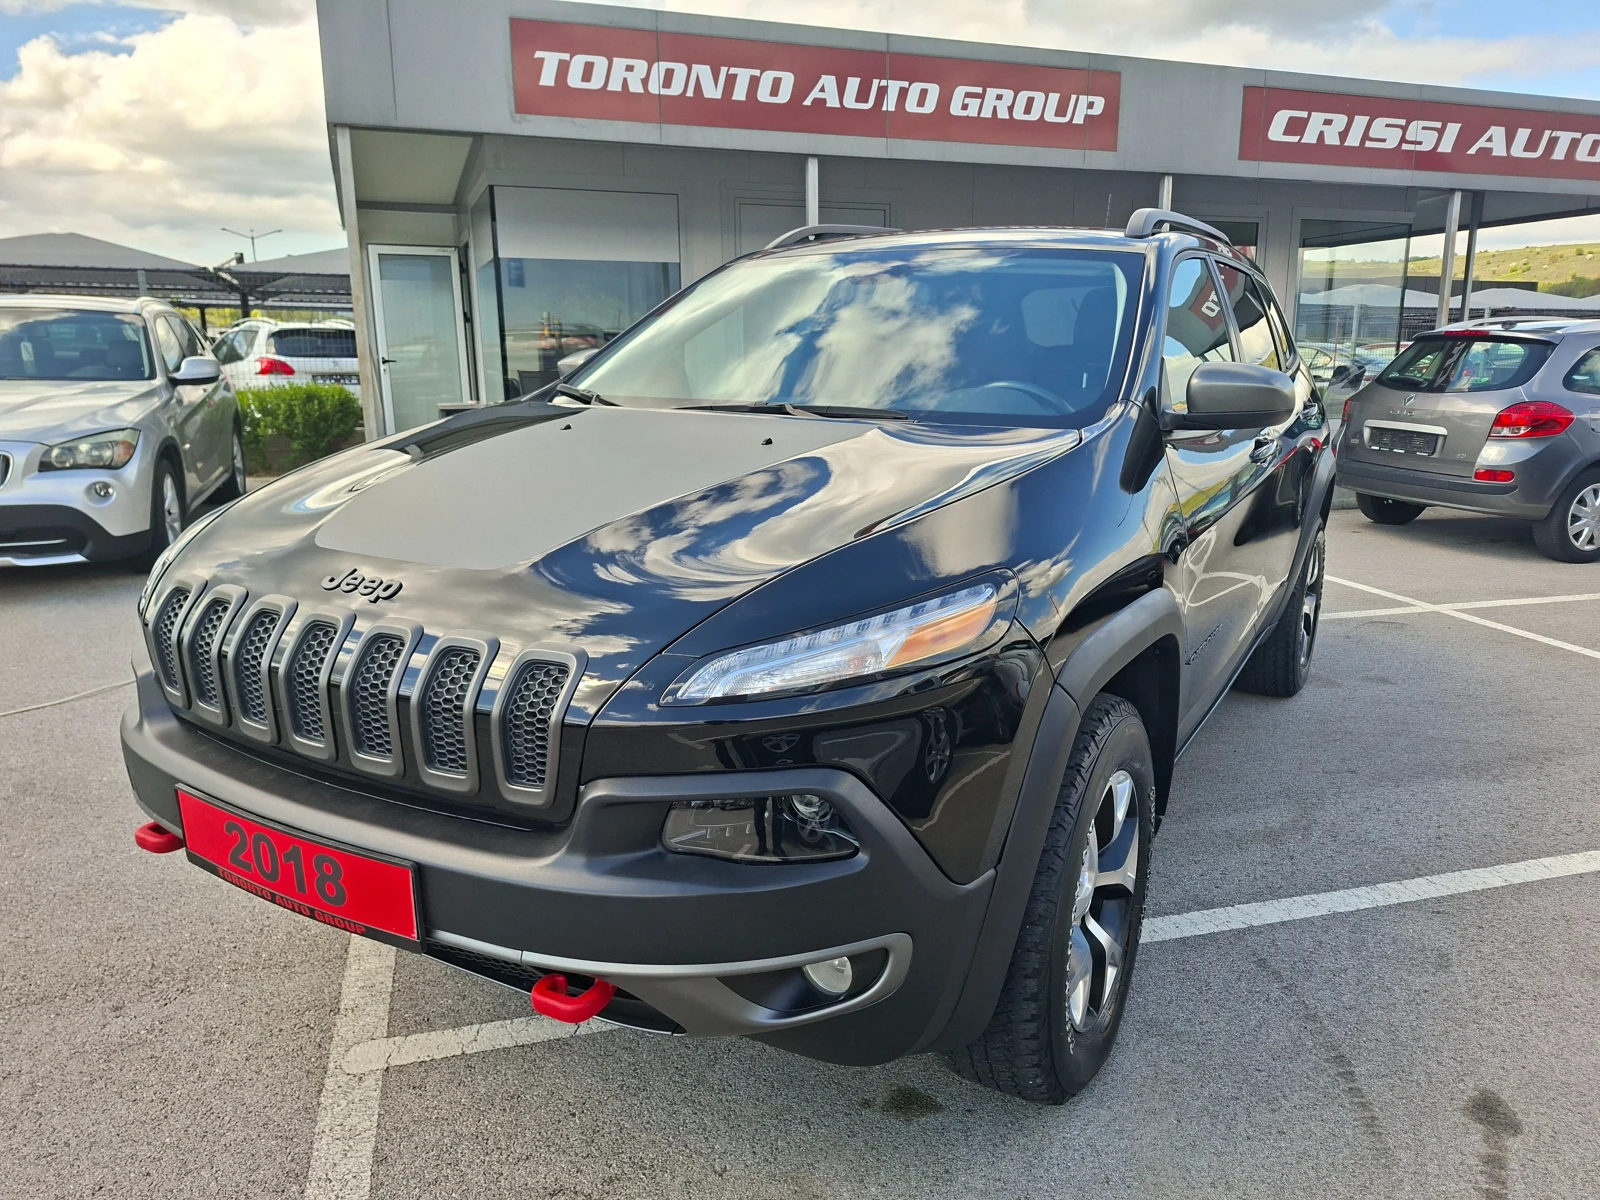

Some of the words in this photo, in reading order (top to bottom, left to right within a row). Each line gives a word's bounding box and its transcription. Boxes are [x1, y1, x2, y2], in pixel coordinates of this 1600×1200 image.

[533, 51, 795, 104] TORONTO
[802, 74, 941, 115] AUTO
[949, 85, 1106, 125] GROUP
[1267, 109, 1462, 153] CRISSI
[1465, 125, 1600, 162] AUTO
[321, 568, 403, 604] Jeep
[224, 821, 347, 906] 2018
[217, 867, 271, 900] TORONTO
[275, 894, 310, 916] AUTO
[314, 910, 366, 935] GROUP
